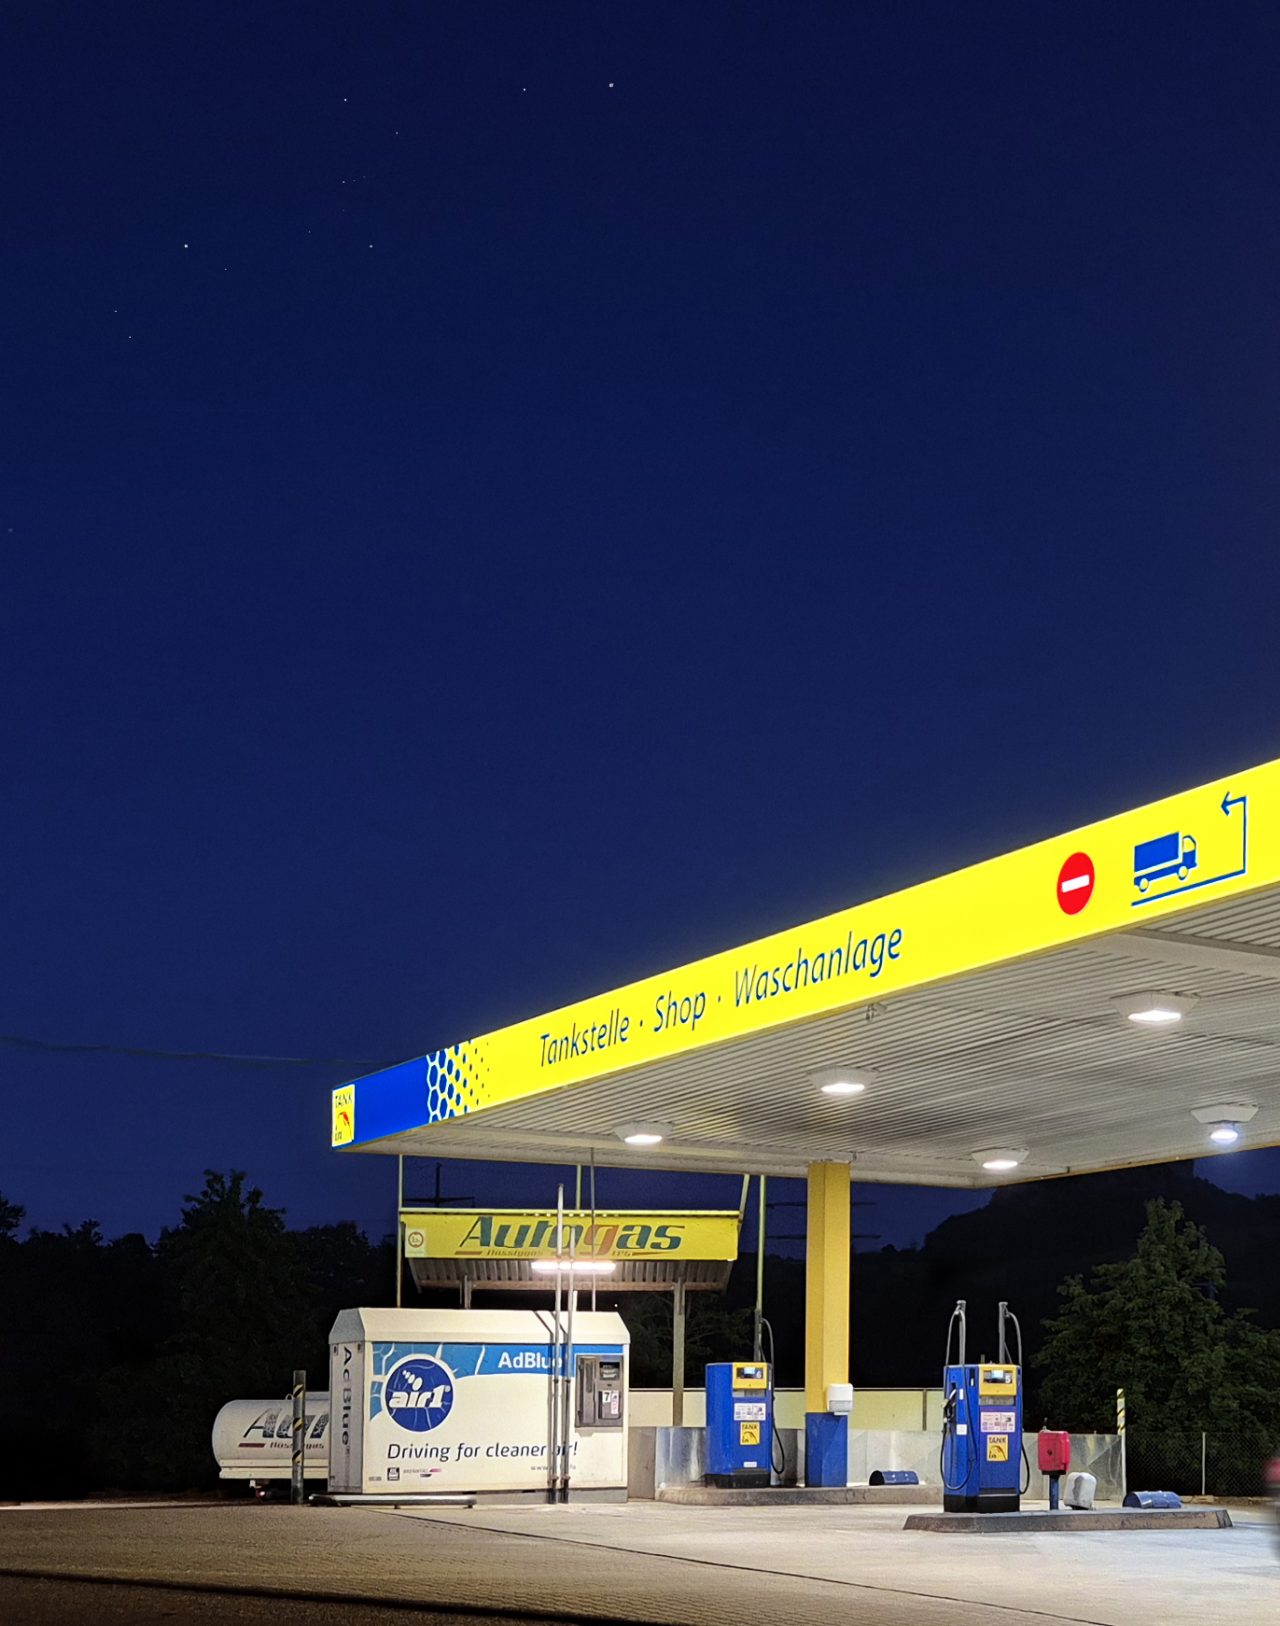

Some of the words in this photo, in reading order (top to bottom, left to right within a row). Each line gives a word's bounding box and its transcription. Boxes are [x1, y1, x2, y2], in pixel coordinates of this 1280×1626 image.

[540, 1008, 630, 1067] Tankstelle
[653, 990, 707, 1031] Shop
[734, 927, 903, 1007] Waschanlage
[459, 1215, 685, 1255] Autogas
[387, 1443, 451, 1462] Driving
[455, 1442, 481, 1461] for
[486, 1441, 547, 1458] cleaner
[551, 1440, 578, 1457] i!
[988, 1436, 1007, 1444] TANK
